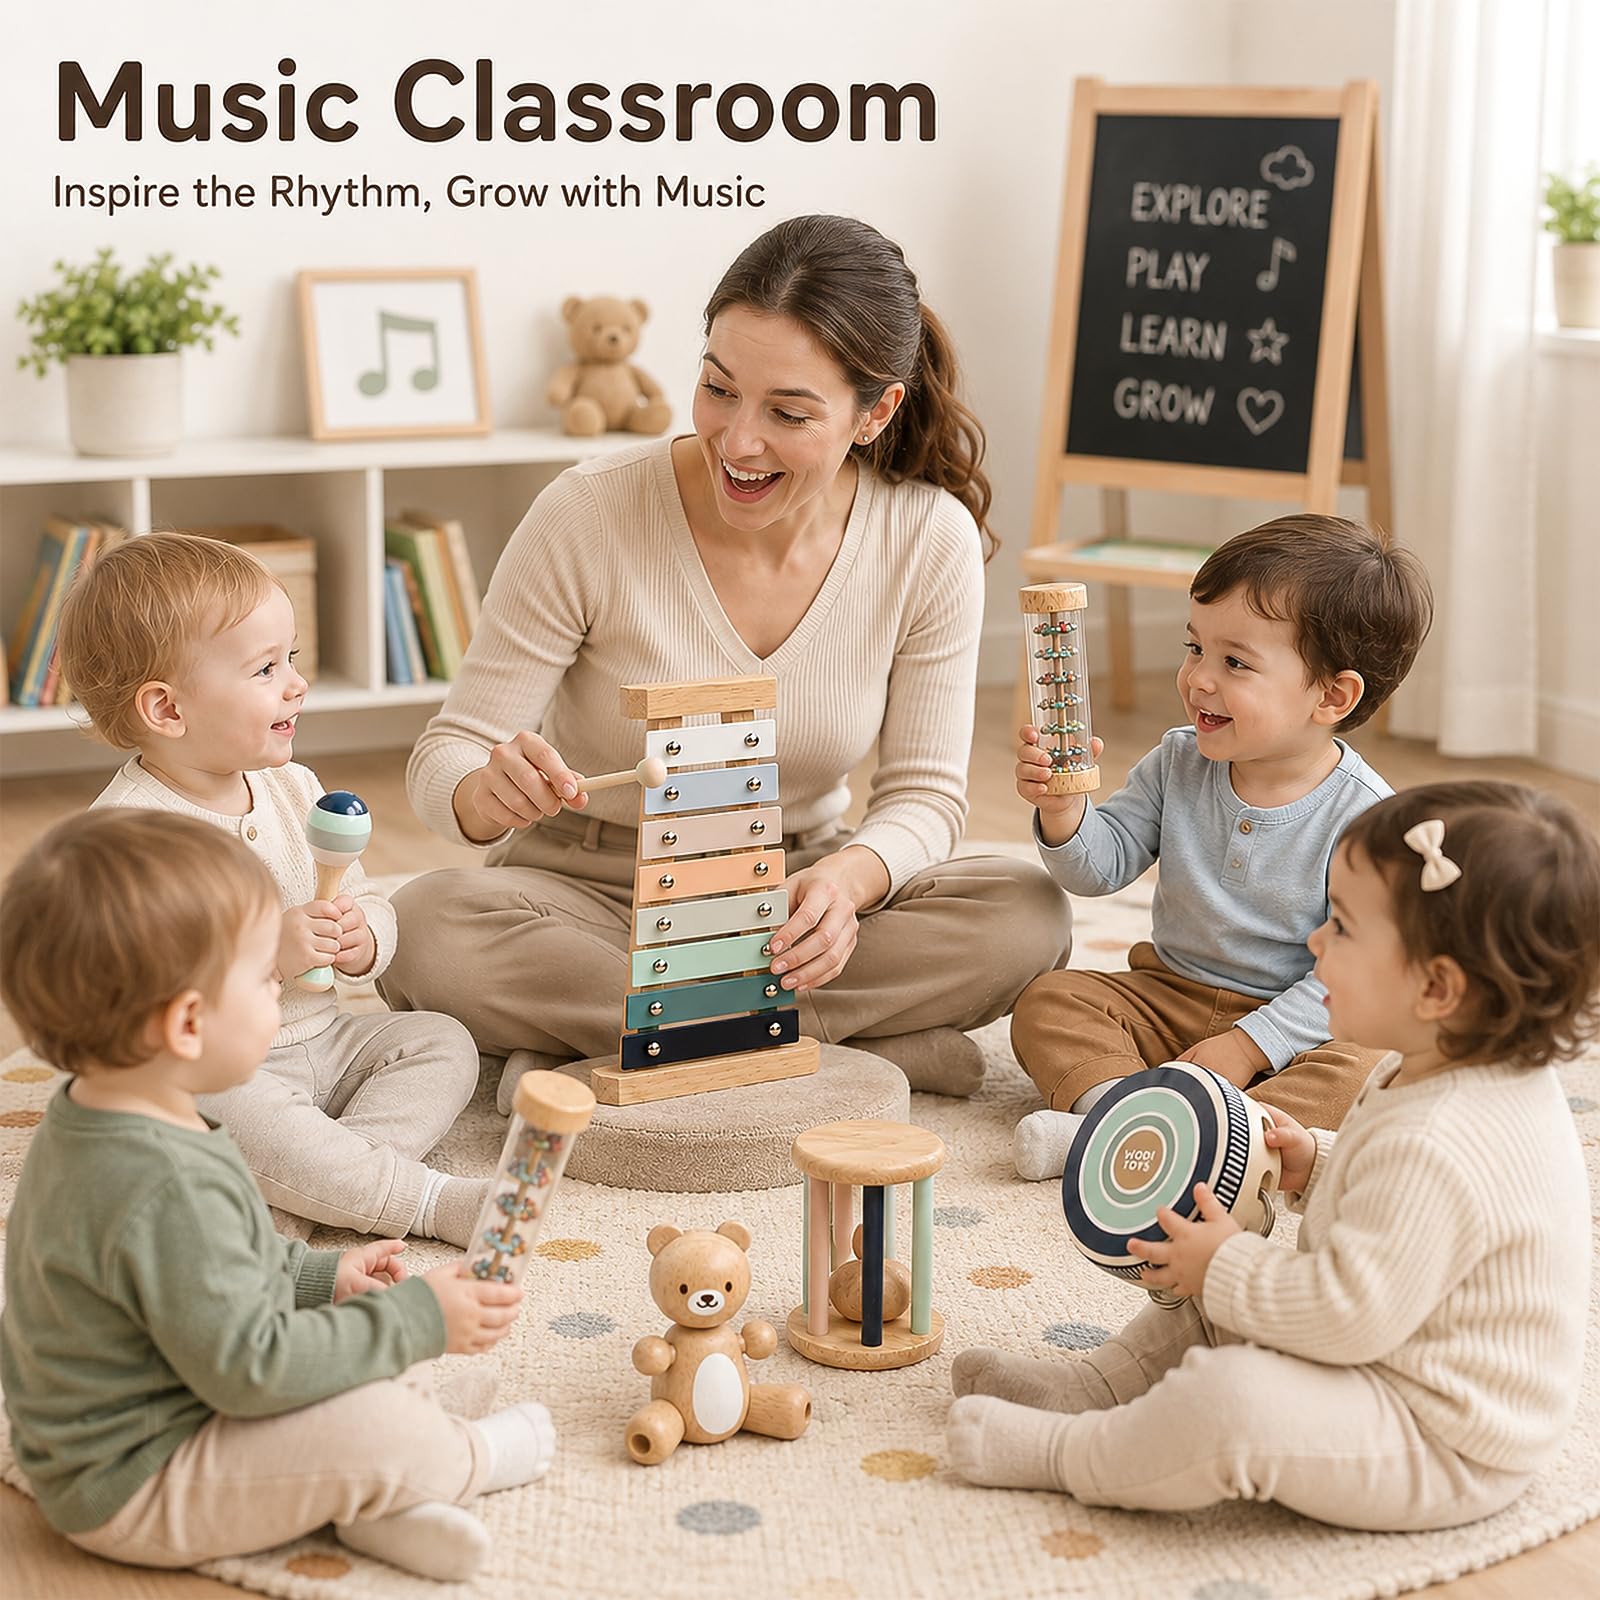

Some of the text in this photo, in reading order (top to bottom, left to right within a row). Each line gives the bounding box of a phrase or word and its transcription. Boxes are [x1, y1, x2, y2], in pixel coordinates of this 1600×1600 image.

[1131, 182, 1271, 229] EXPLORE
[1126, 247, 1210, 292] PLAY
[1119, 312, 1228, 361] LEARN
[1113, 377, 1215, 425] GROW
[1122, 1160, 1151, 1172] TOYS
